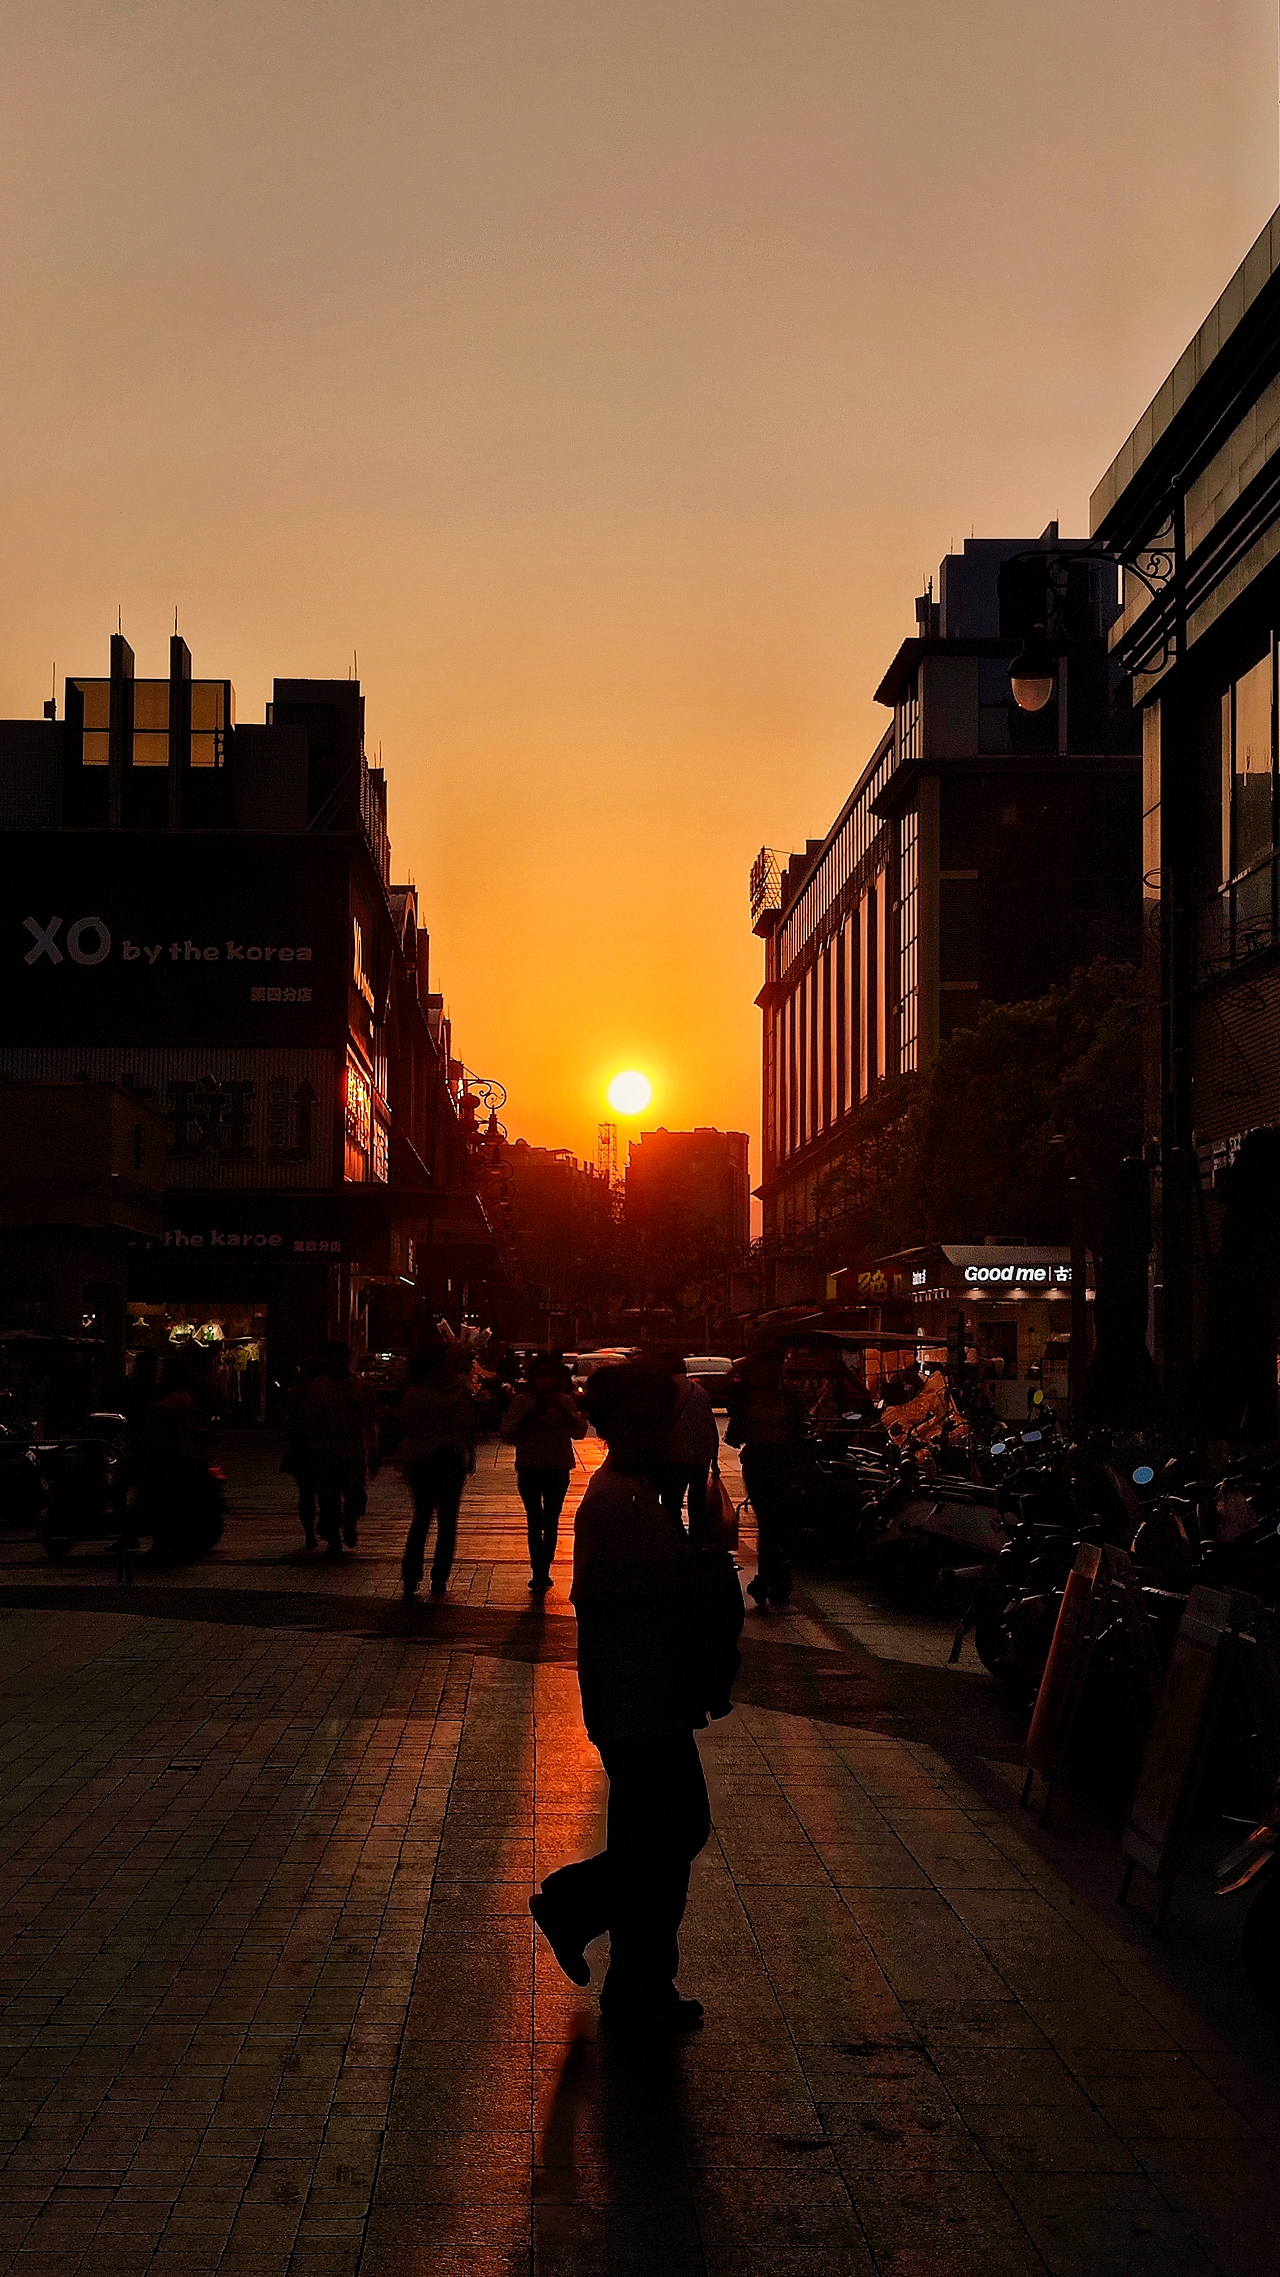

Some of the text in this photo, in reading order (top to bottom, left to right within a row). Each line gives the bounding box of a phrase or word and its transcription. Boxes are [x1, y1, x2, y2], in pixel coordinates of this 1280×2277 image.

[22, 915, 312, 966] XO by the korea
[251, 986, 312, 1003] 第四分店
[164, 1229, 204, 1246] the
[210, 1229, 282, 1246] karoe
[964, 1265, 1046, 1281] Good me
[1054, 1265, 1072, 1282] 古
